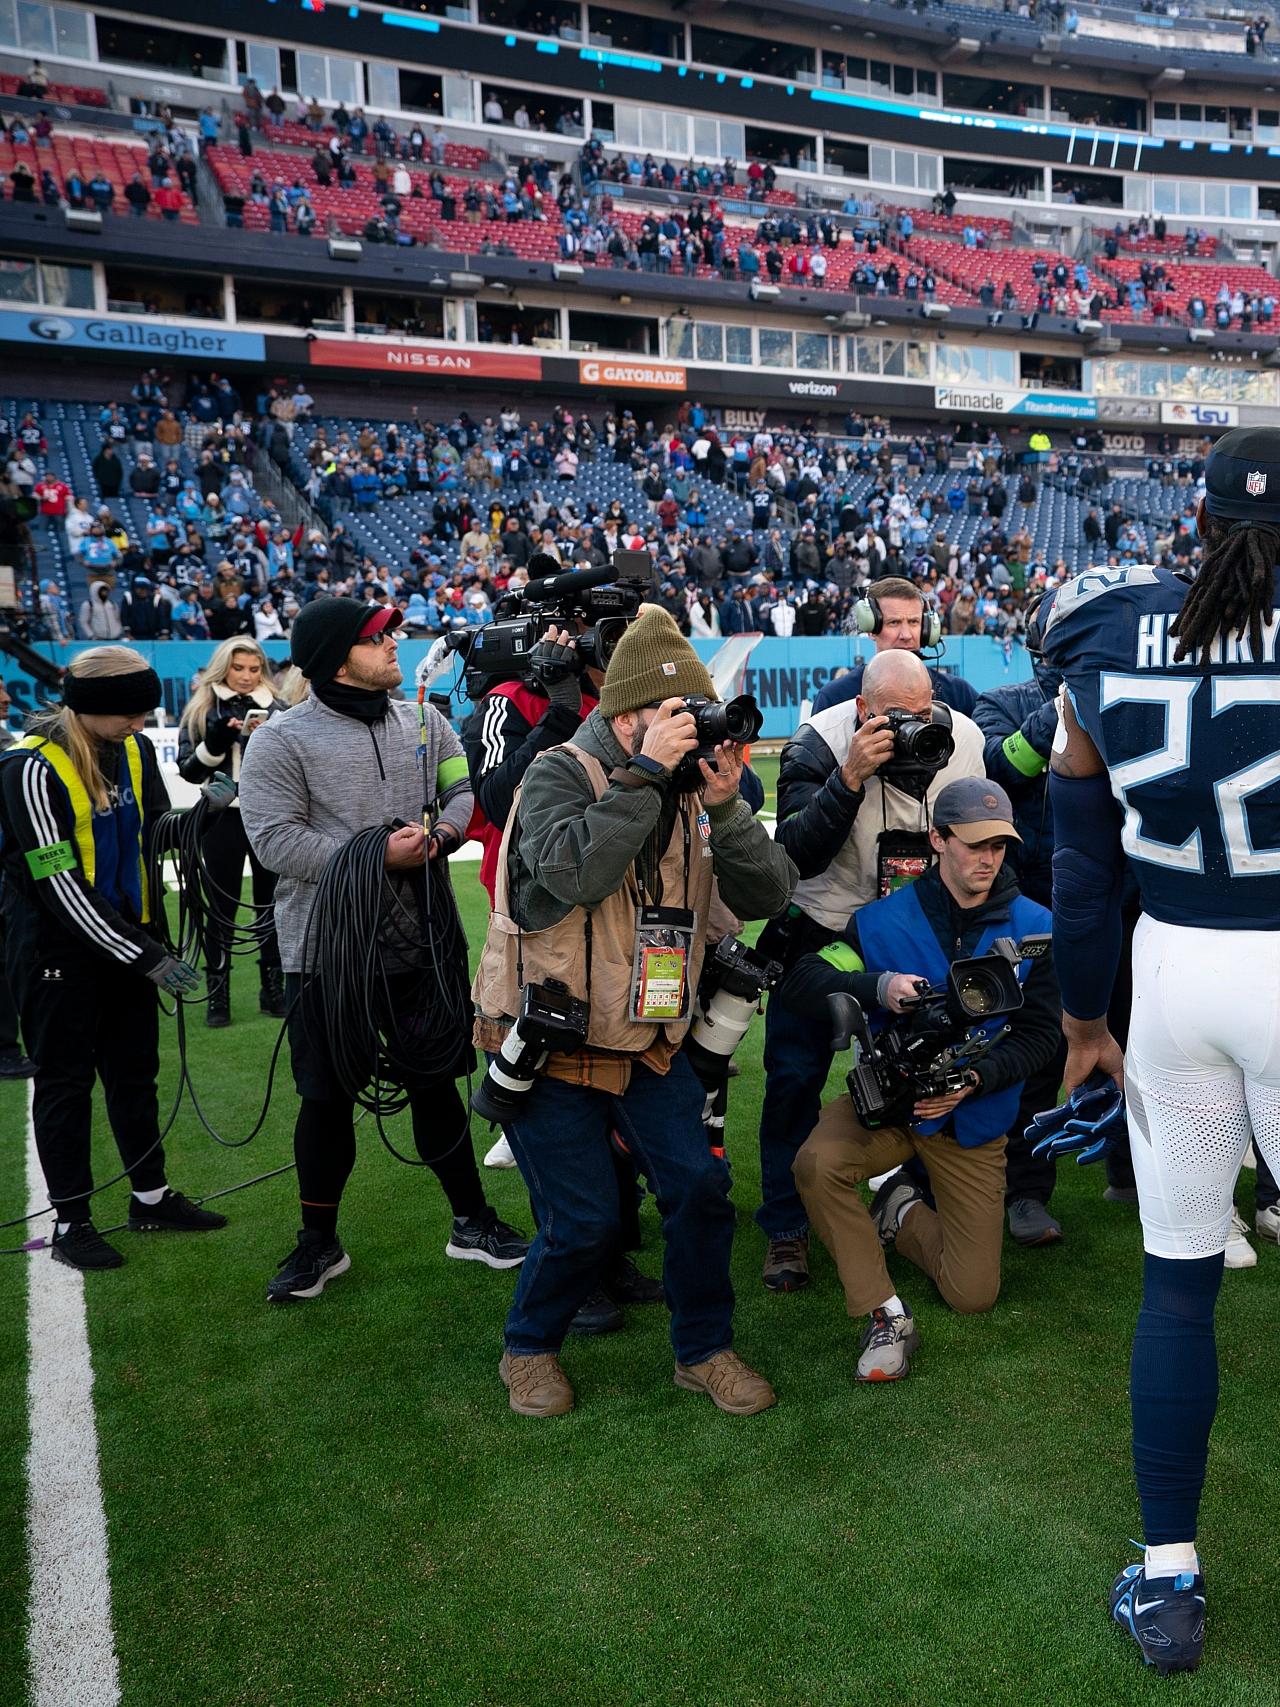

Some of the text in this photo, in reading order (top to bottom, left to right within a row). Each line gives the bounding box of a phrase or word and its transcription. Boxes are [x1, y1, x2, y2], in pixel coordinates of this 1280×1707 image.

[85, 322, 227, 352] Gallagher
[387, 351, 471, 369] NISSAN
[603, 368, 684, 385] GATORADE
[789, 381, 837, 397] verizon
[938, 388, 1004, 410] Pinnacle
[724, 409, 767, 426] BILLY
[1191, 408, 1230, 424] tsu
[1249, 480, 1264, 492] NFL
[755, 494, 769, 507] 22
[38, 850, 57, 862] WEEK
